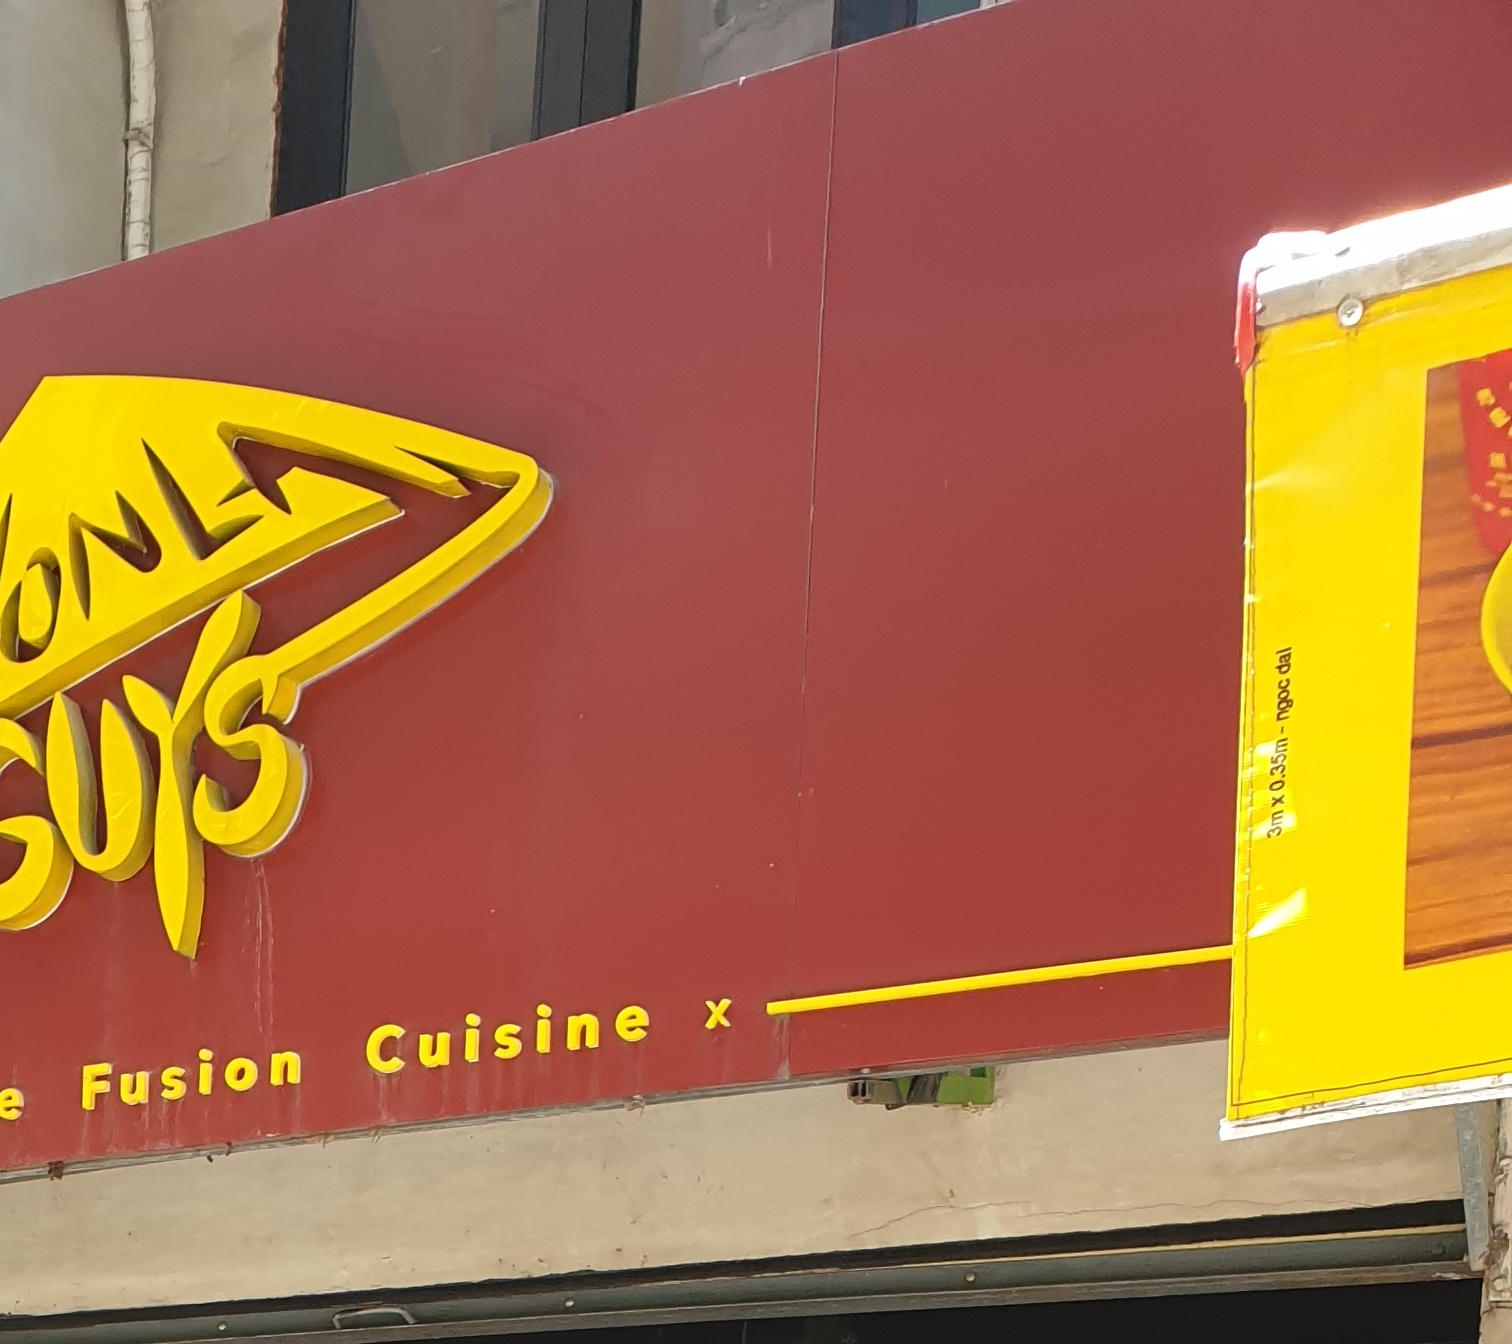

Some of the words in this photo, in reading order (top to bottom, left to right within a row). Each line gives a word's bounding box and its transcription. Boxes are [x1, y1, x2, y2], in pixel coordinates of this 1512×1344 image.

[1276, 678, 1294, 722] ngoc
[1269, 737, 1289, 791] 0.35m
[1267, 810, 1284, 839] 3m
[81, 1048, 302, 1110] Fusion
[366, 1004, 650, 1074] Cuisine
